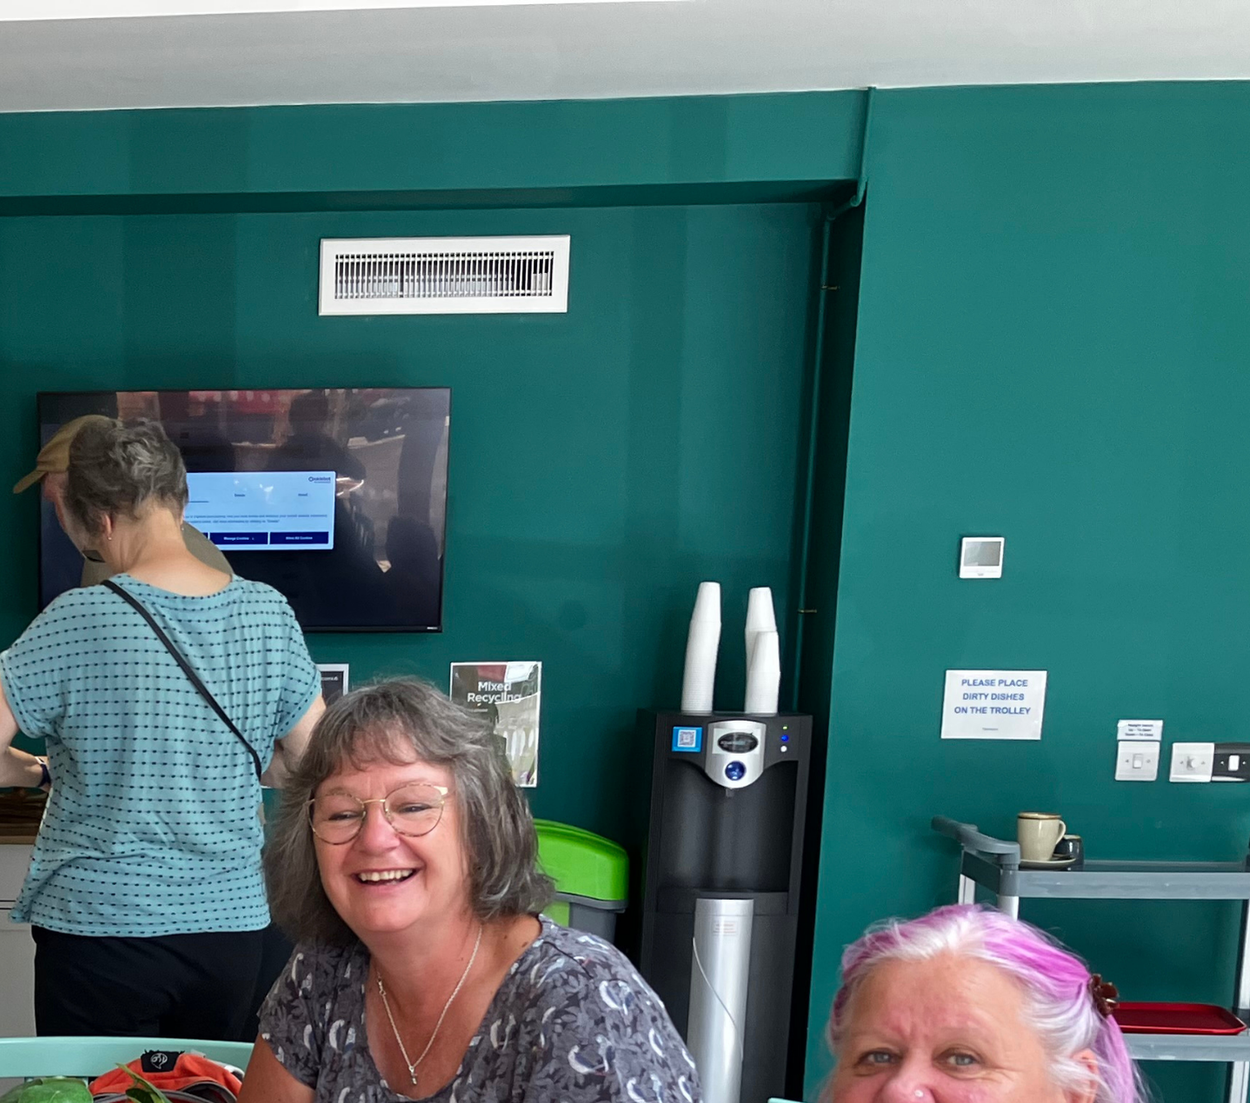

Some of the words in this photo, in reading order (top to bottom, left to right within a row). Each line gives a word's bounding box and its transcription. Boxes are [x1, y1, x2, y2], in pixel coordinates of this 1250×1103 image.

[478, 681, 512, 691] Mixed
[961, 679, 996, 687] PLEASE
[997, 679, 1028, 687] PLACE
[467, 692, 522, 704] Recycling
[954, 706, 968, 714] ON
[970, 706, 988, 714] THE
[990, 706, 1031, 715] TROLLEY
